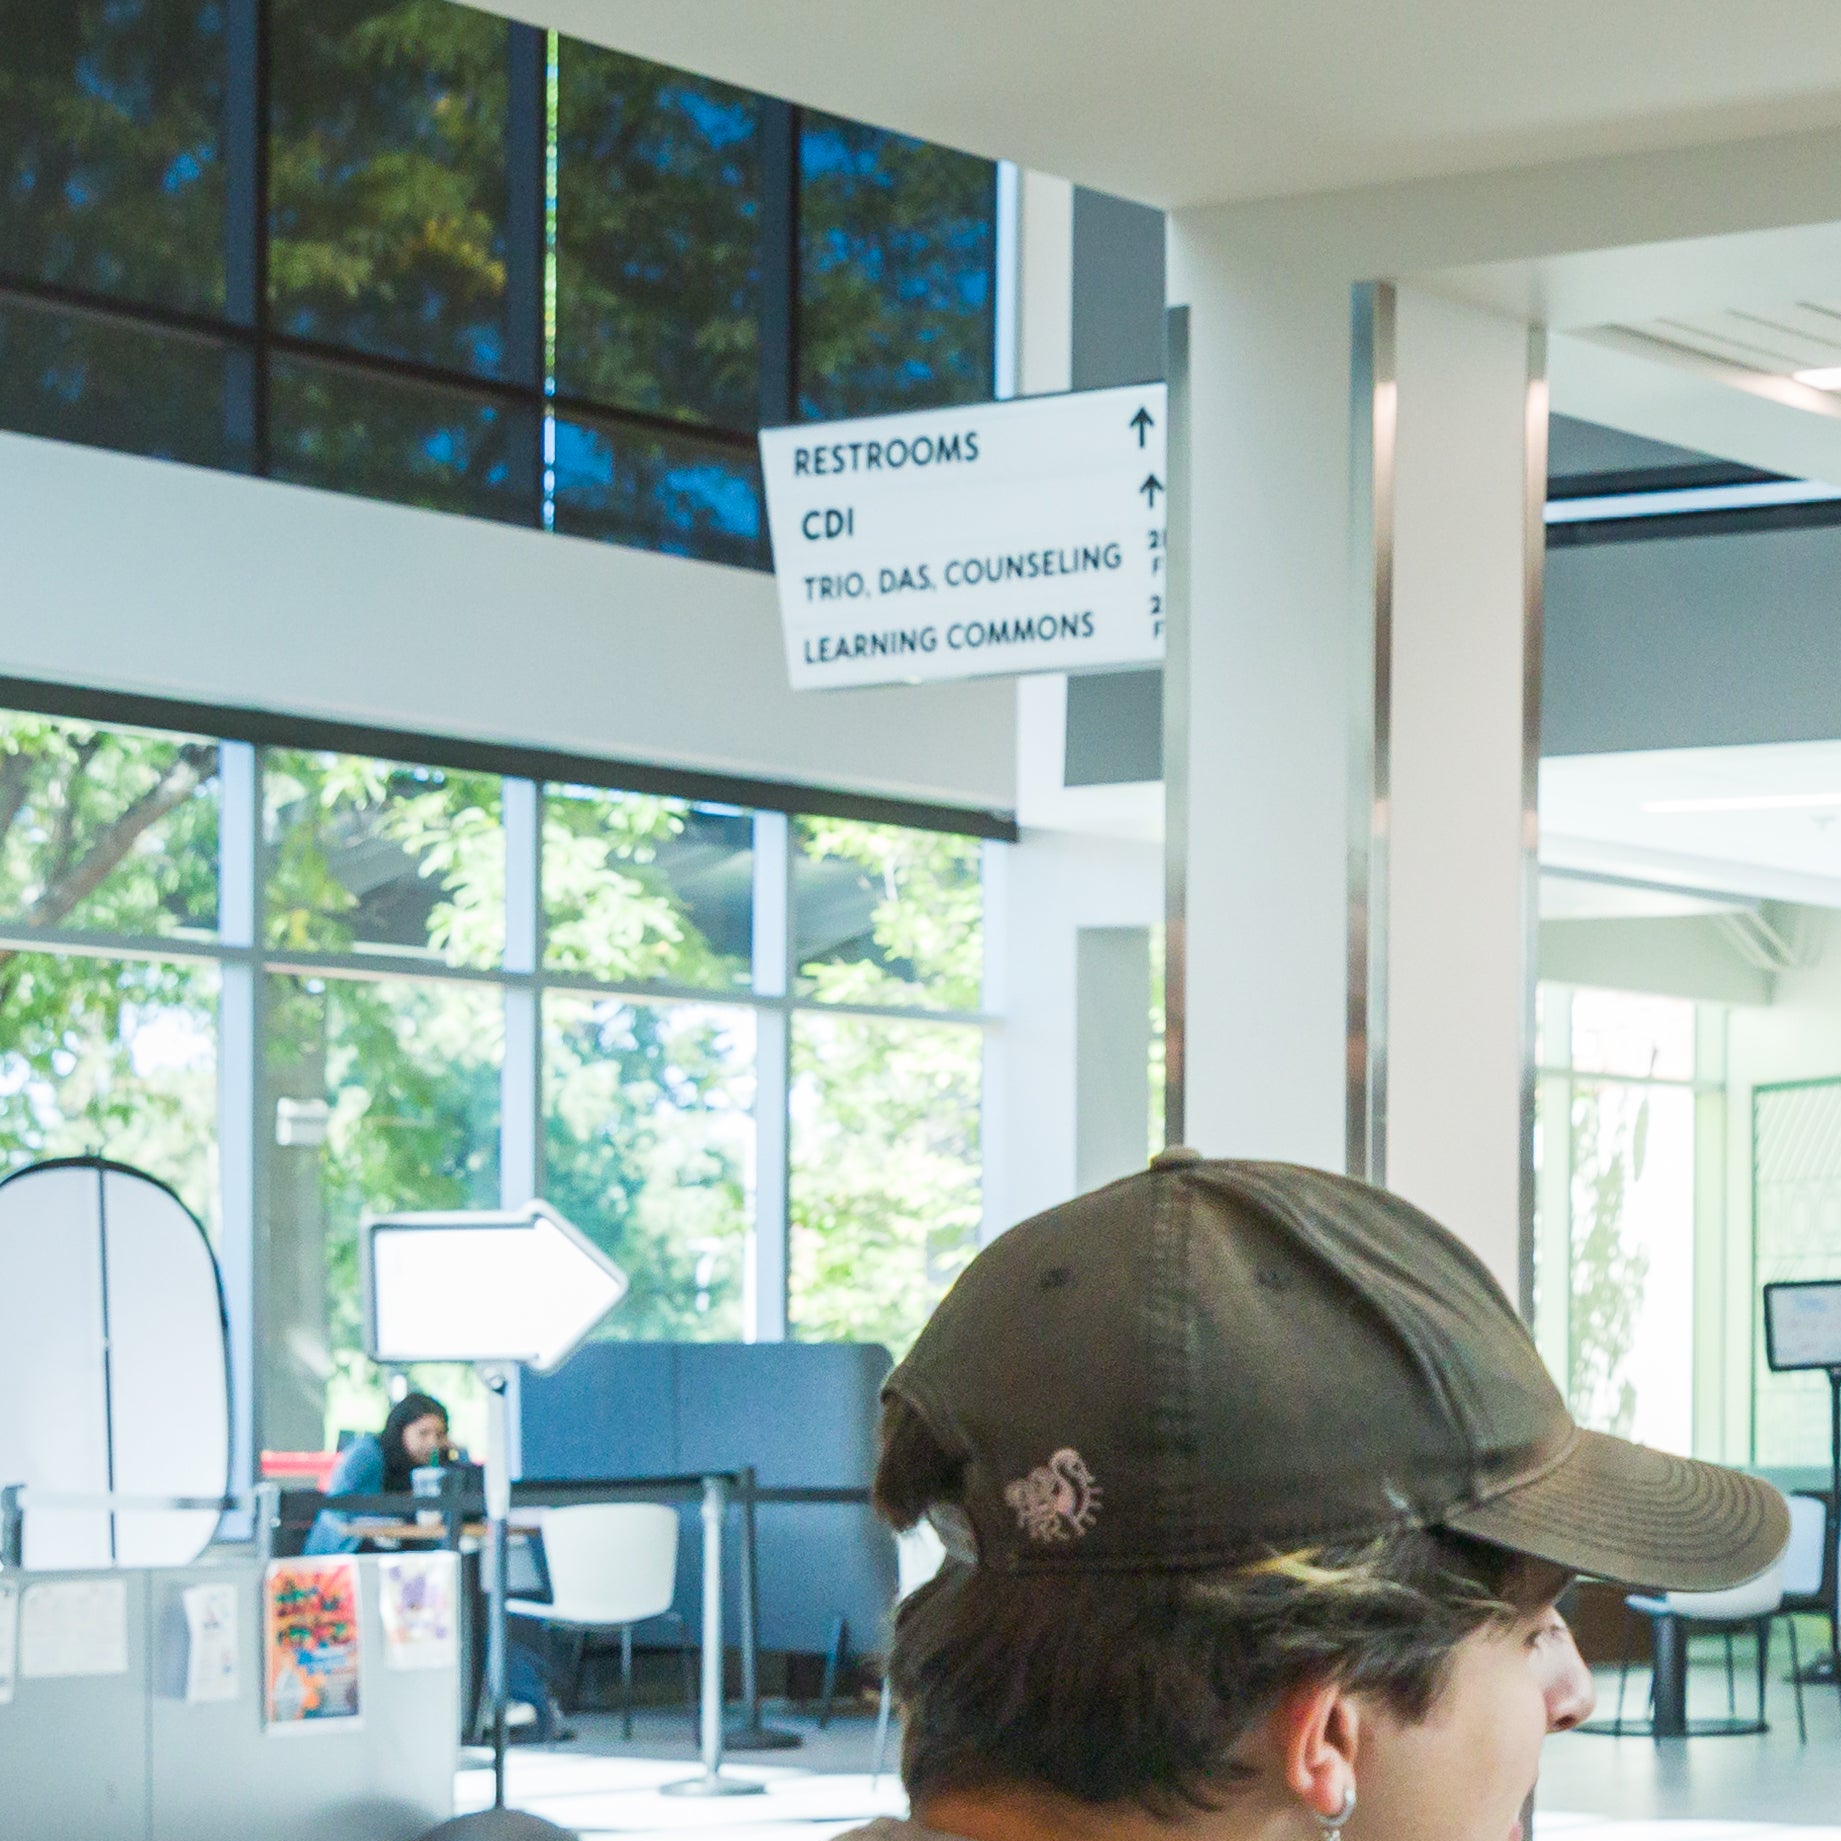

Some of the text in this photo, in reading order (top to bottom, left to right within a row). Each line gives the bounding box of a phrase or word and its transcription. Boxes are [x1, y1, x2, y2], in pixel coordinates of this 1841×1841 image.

[794, 431, 980, 478] RESTROOMS
[801, 507, 855, 541] CDI
[944, 541, 1123, 588] COUNSELING
[804, 610, 1095, 664] LEARNING COMMONS
